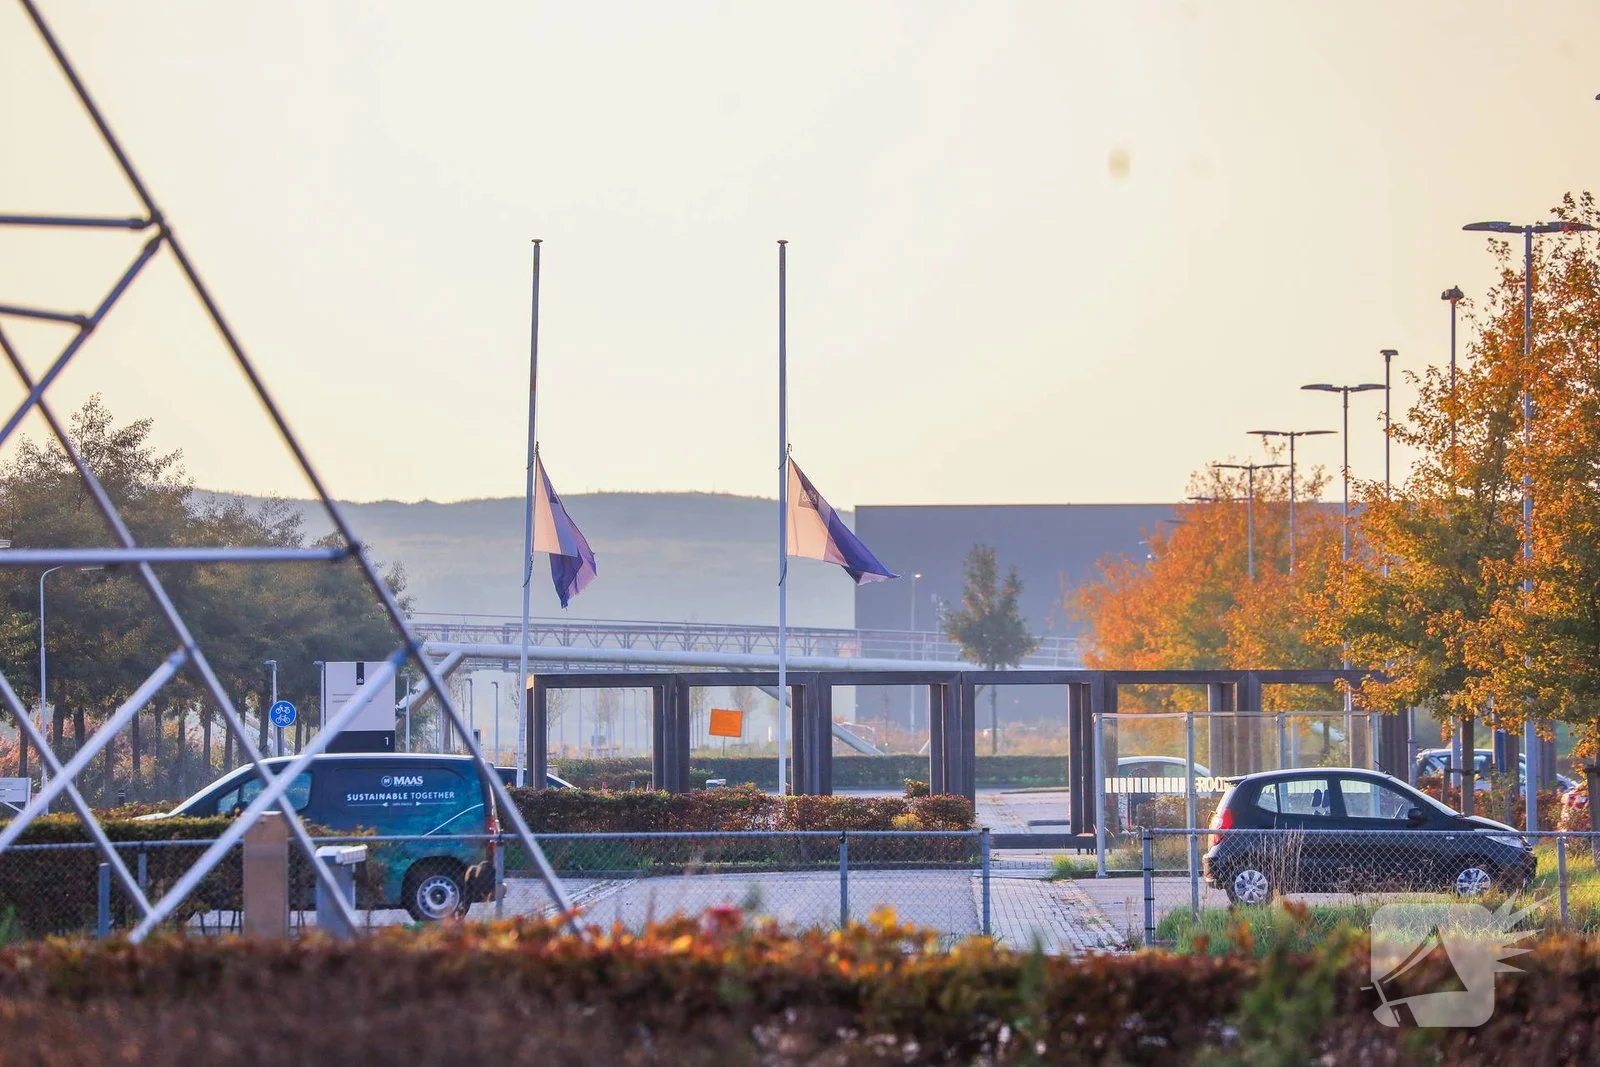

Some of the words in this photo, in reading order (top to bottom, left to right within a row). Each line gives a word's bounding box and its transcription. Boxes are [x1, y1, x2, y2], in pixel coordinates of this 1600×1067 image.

[384, 736, 389, 746] 1
[393, 775, 424, 785] MAAS
[346, 792, 408, 801] SUSTAINABLE
[411, 791, 455, 800] TOGETHER
